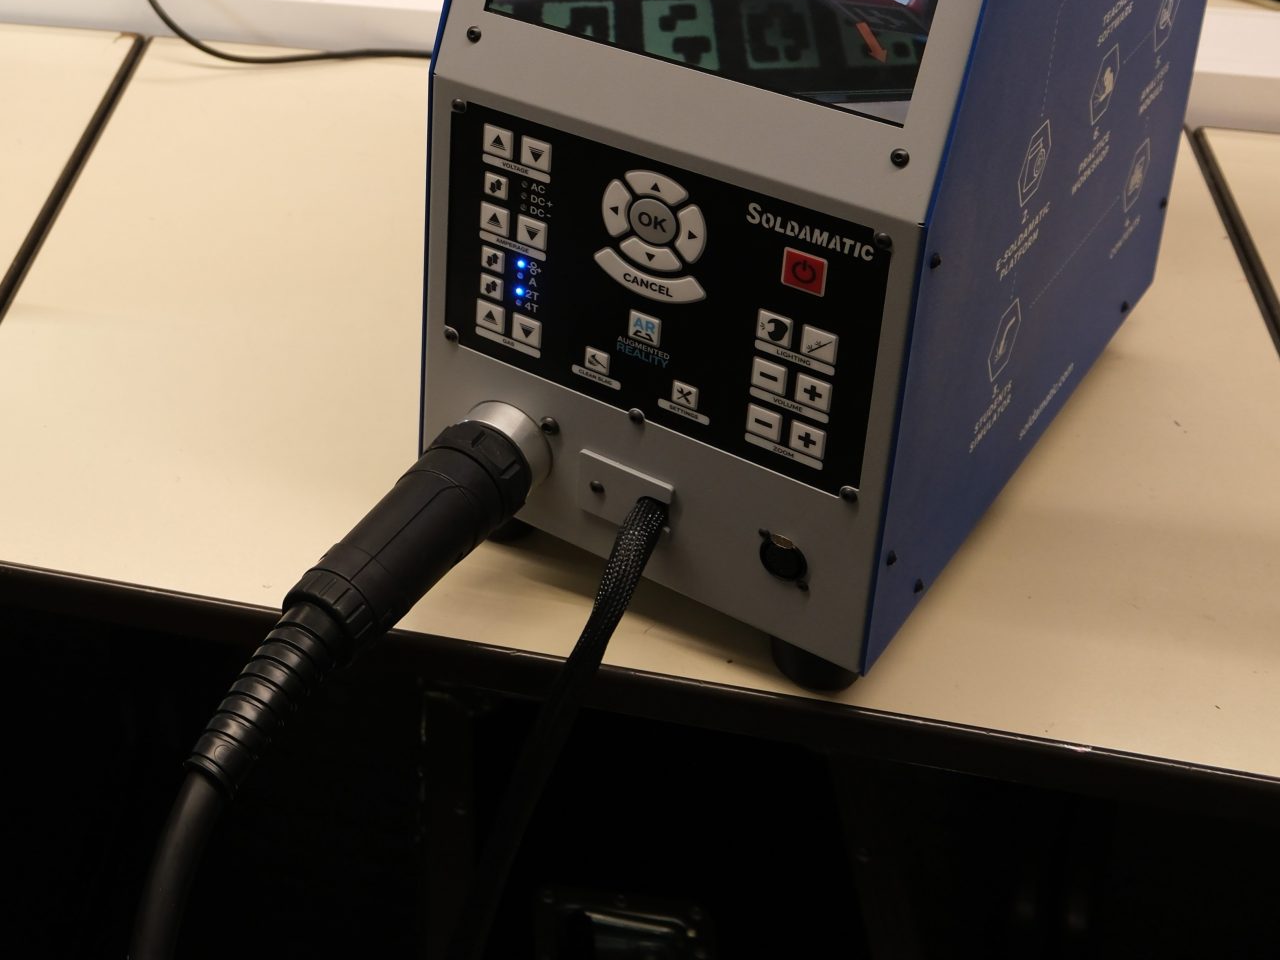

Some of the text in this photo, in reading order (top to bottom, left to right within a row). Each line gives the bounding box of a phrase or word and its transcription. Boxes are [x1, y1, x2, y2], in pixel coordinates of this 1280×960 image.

[502, 160, 529, 176] VOLTAGE
[530, 183, 546, 194] AC
[638, 212, 667, 233] OK
[746, 202, 874, 262] SOLDAMATIC
[496, 237, 530, 254] AMPERAGE
[528, 277, 537, 288] A
[623, 273, 673, 298] CANCEL
[526, 289, 540, 301] 2T
[524, 301, 539, 314] 4T
[633, 317, 656, 335] AR
[616, 341, 670, 369] REALITY
[617, 335, 670, 361] AUGMENTED
[776, 349, 811, 366] LIGHTING
[578, 368, 597, 381] CLEAN
[669, 404, 699, 420] SETTINGS
[773, 397, 803, 413] VOLUME
[773, 445, 795, 458] ZOOM
